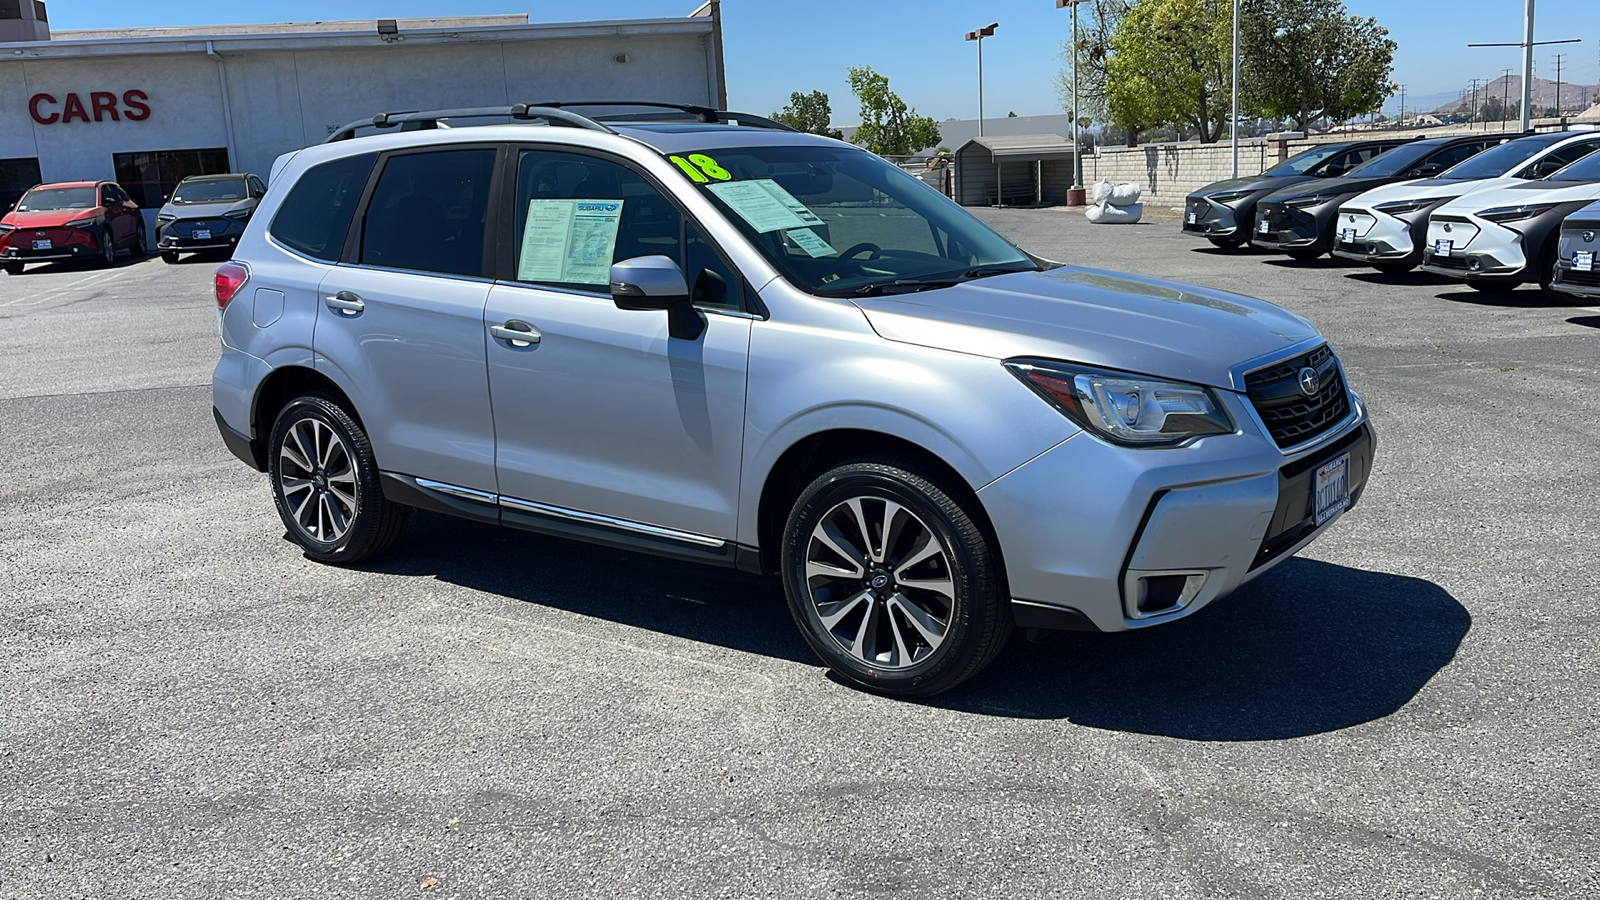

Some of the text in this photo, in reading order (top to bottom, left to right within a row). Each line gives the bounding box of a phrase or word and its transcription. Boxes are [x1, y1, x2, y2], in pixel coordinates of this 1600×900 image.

[29, 89, 151, 125] CARS
[669, 153, 732, 183] 18
[1324, 458, 1342, 473] SUBARU
